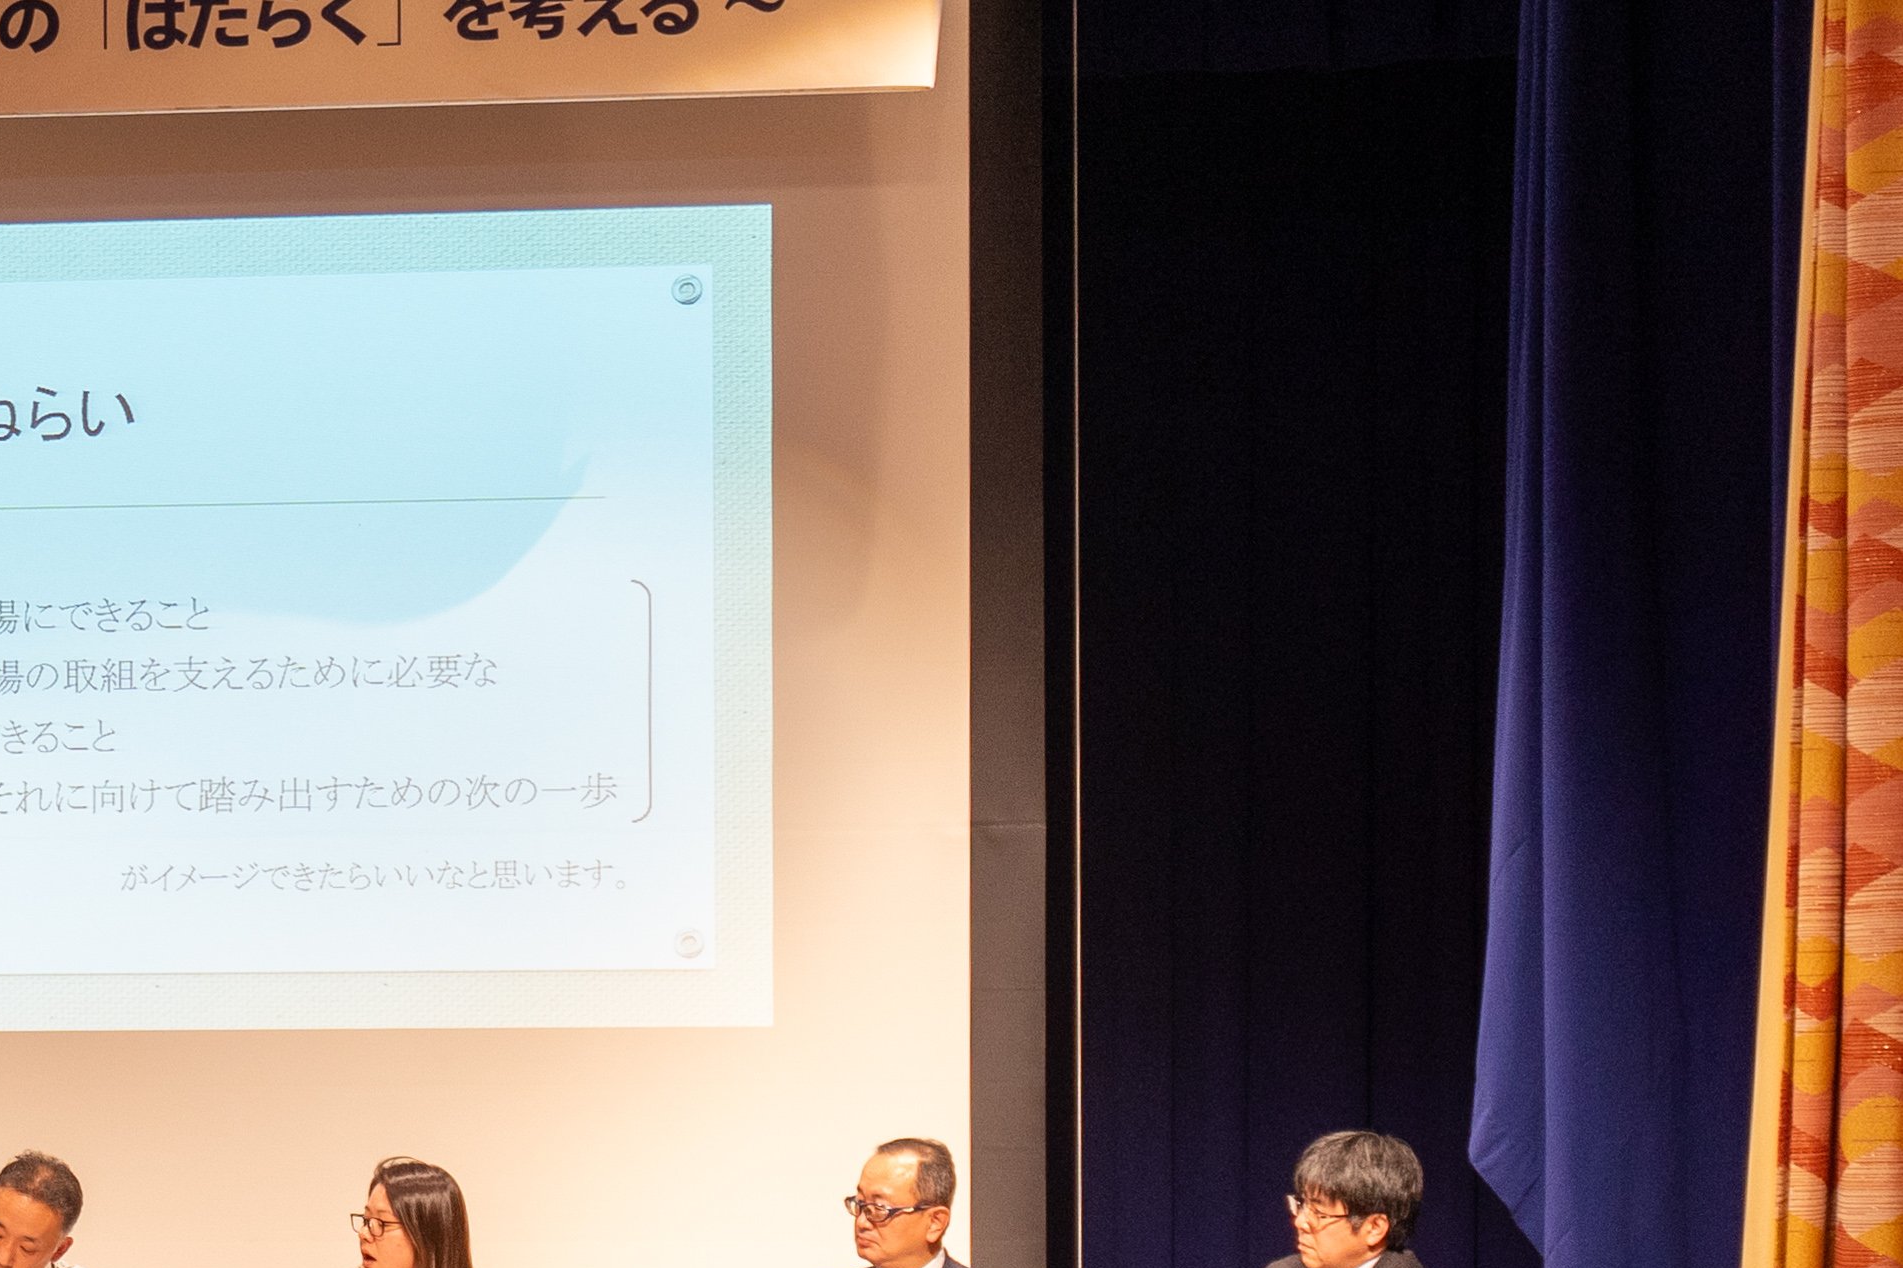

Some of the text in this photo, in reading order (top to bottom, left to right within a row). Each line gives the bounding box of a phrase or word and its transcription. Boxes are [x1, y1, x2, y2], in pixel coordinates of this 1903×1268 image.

[120, 858, 627, 892] がイメージできたらいいなと思います。
